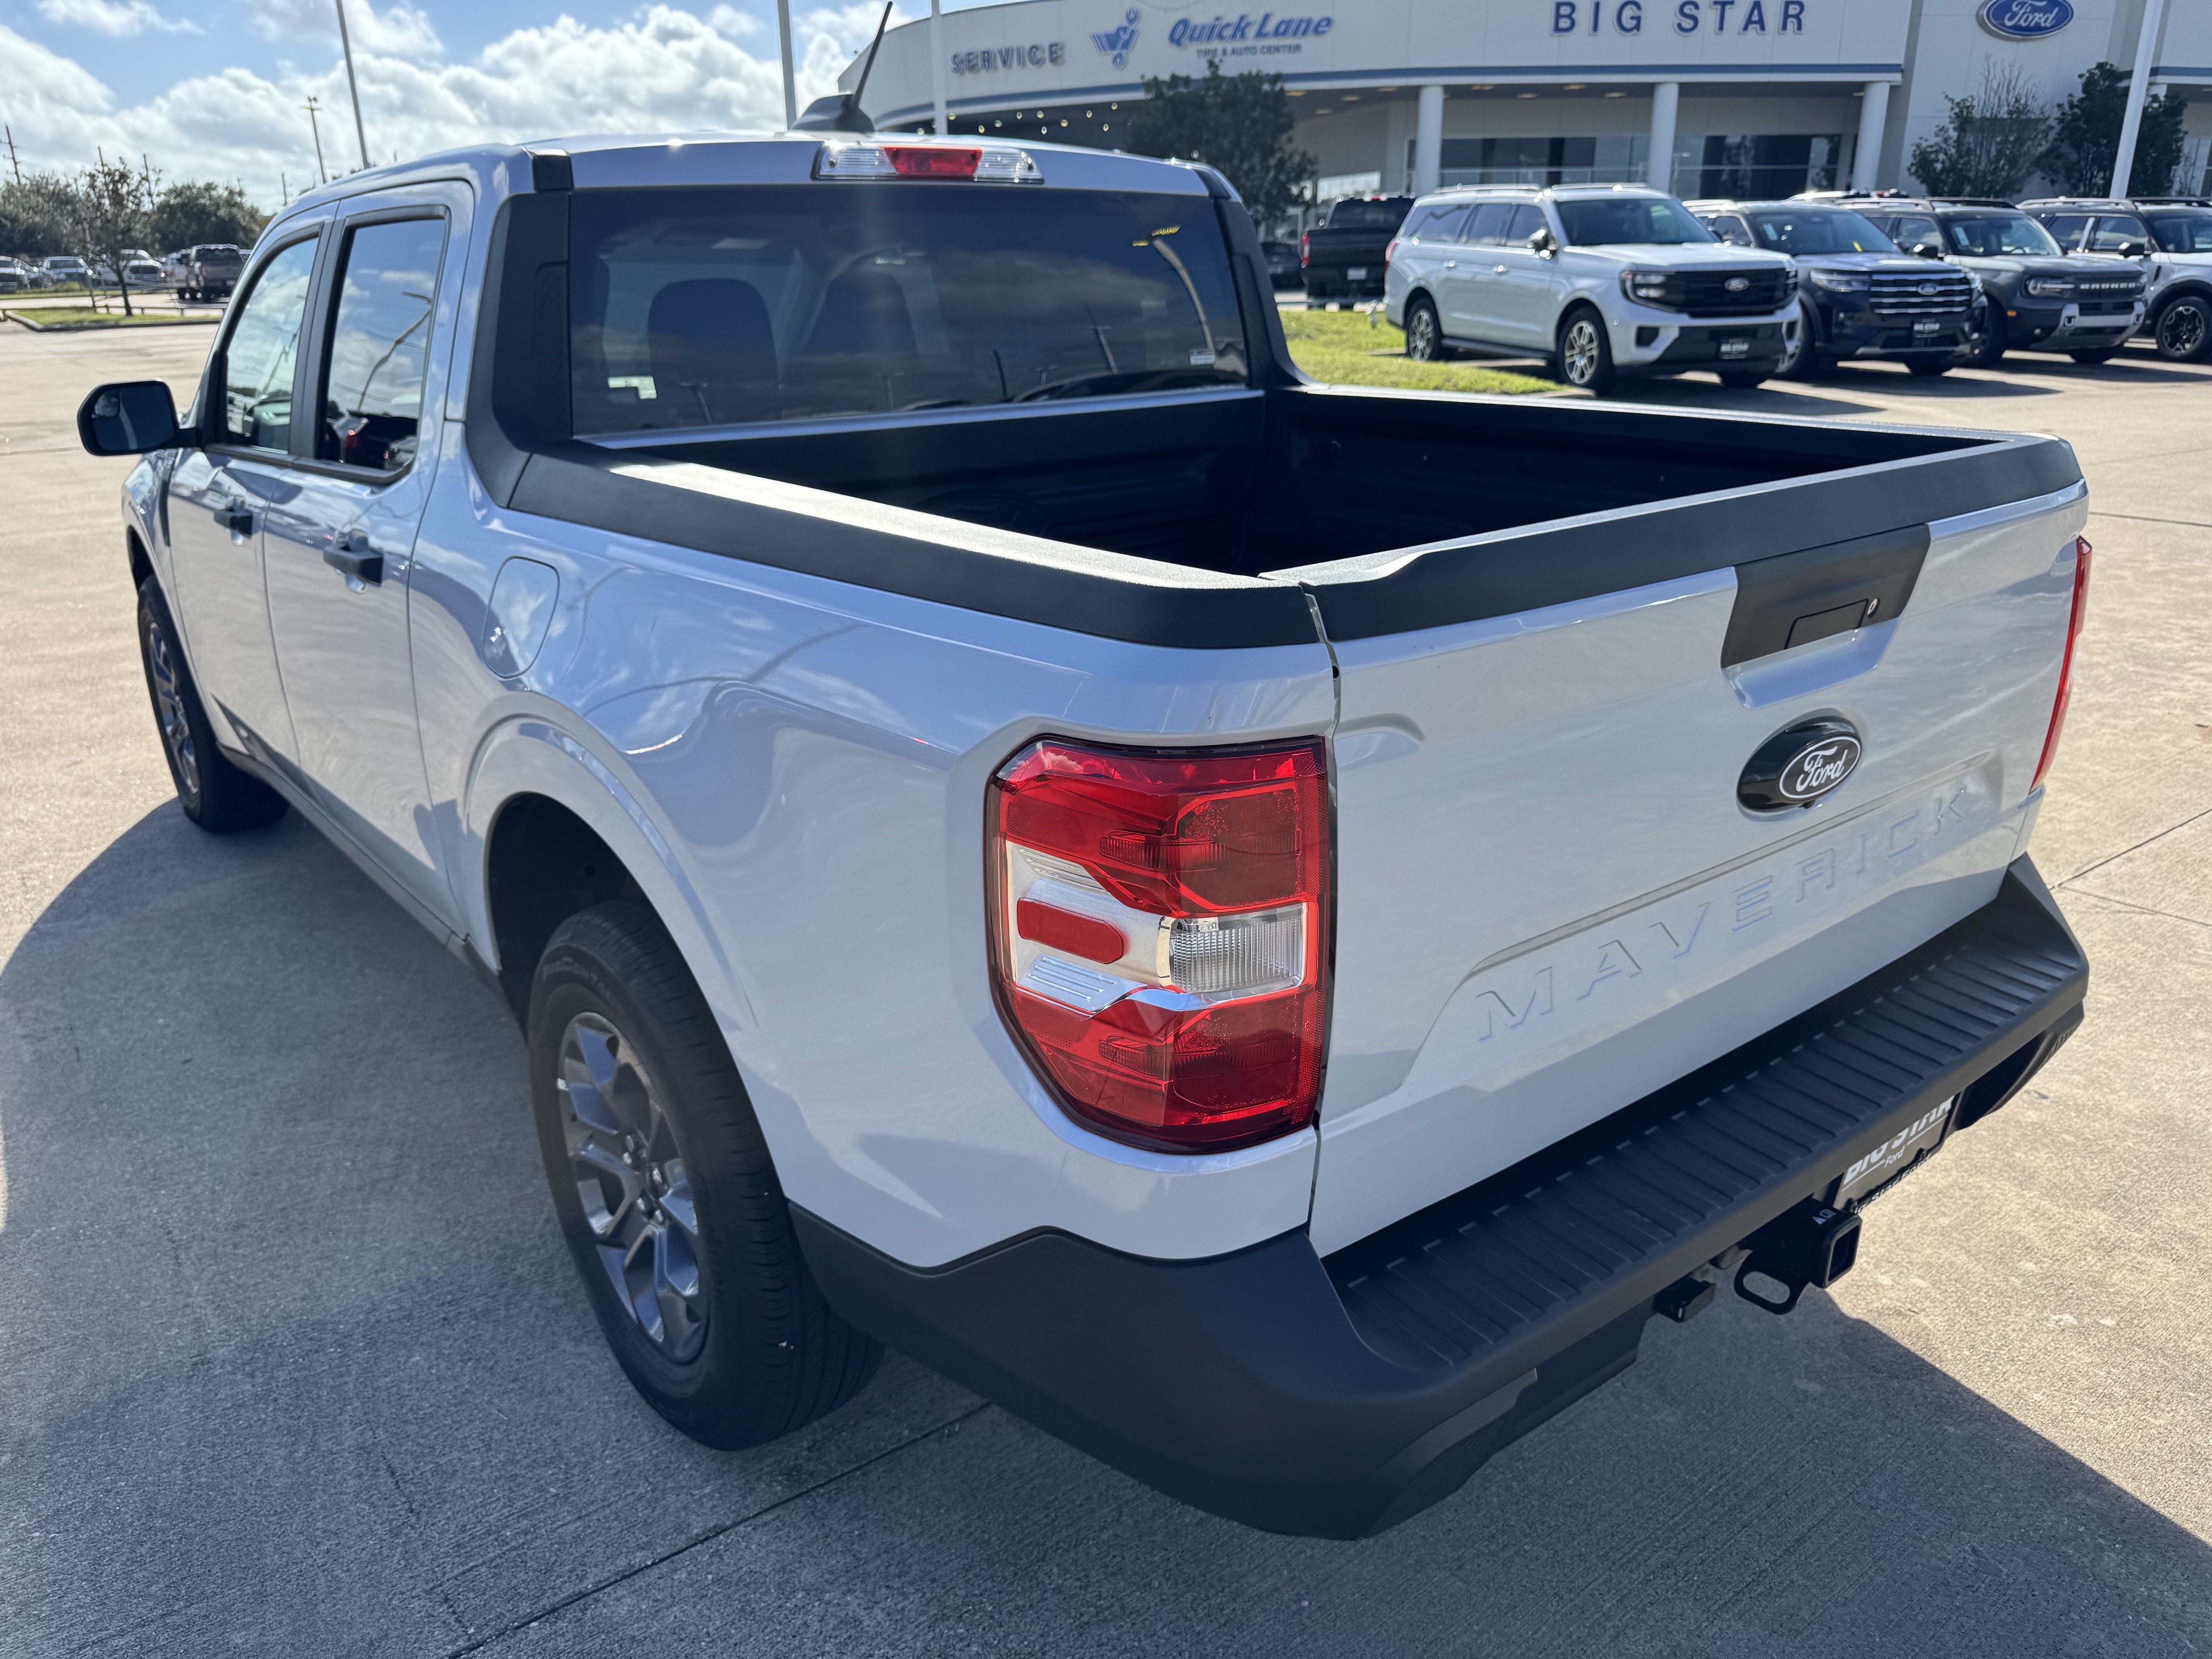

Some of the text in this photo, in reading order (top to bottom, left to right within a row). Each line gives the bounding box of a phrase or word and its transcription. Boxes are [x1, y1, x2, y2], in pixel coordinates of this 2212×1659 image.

[1168, 12, 1332, 46] Quick Lane
[1553, 0, 1805, 33] BIG STAR
[2004, 0, 2059, 27] Ford
[950, 43, 1062, 74] SERVICE
[1795, 745, 1848, 792] Ford
[1475, 787, 1965, 1042] MAVERICK
[1884, 1145, 1905, 1168] Ford
